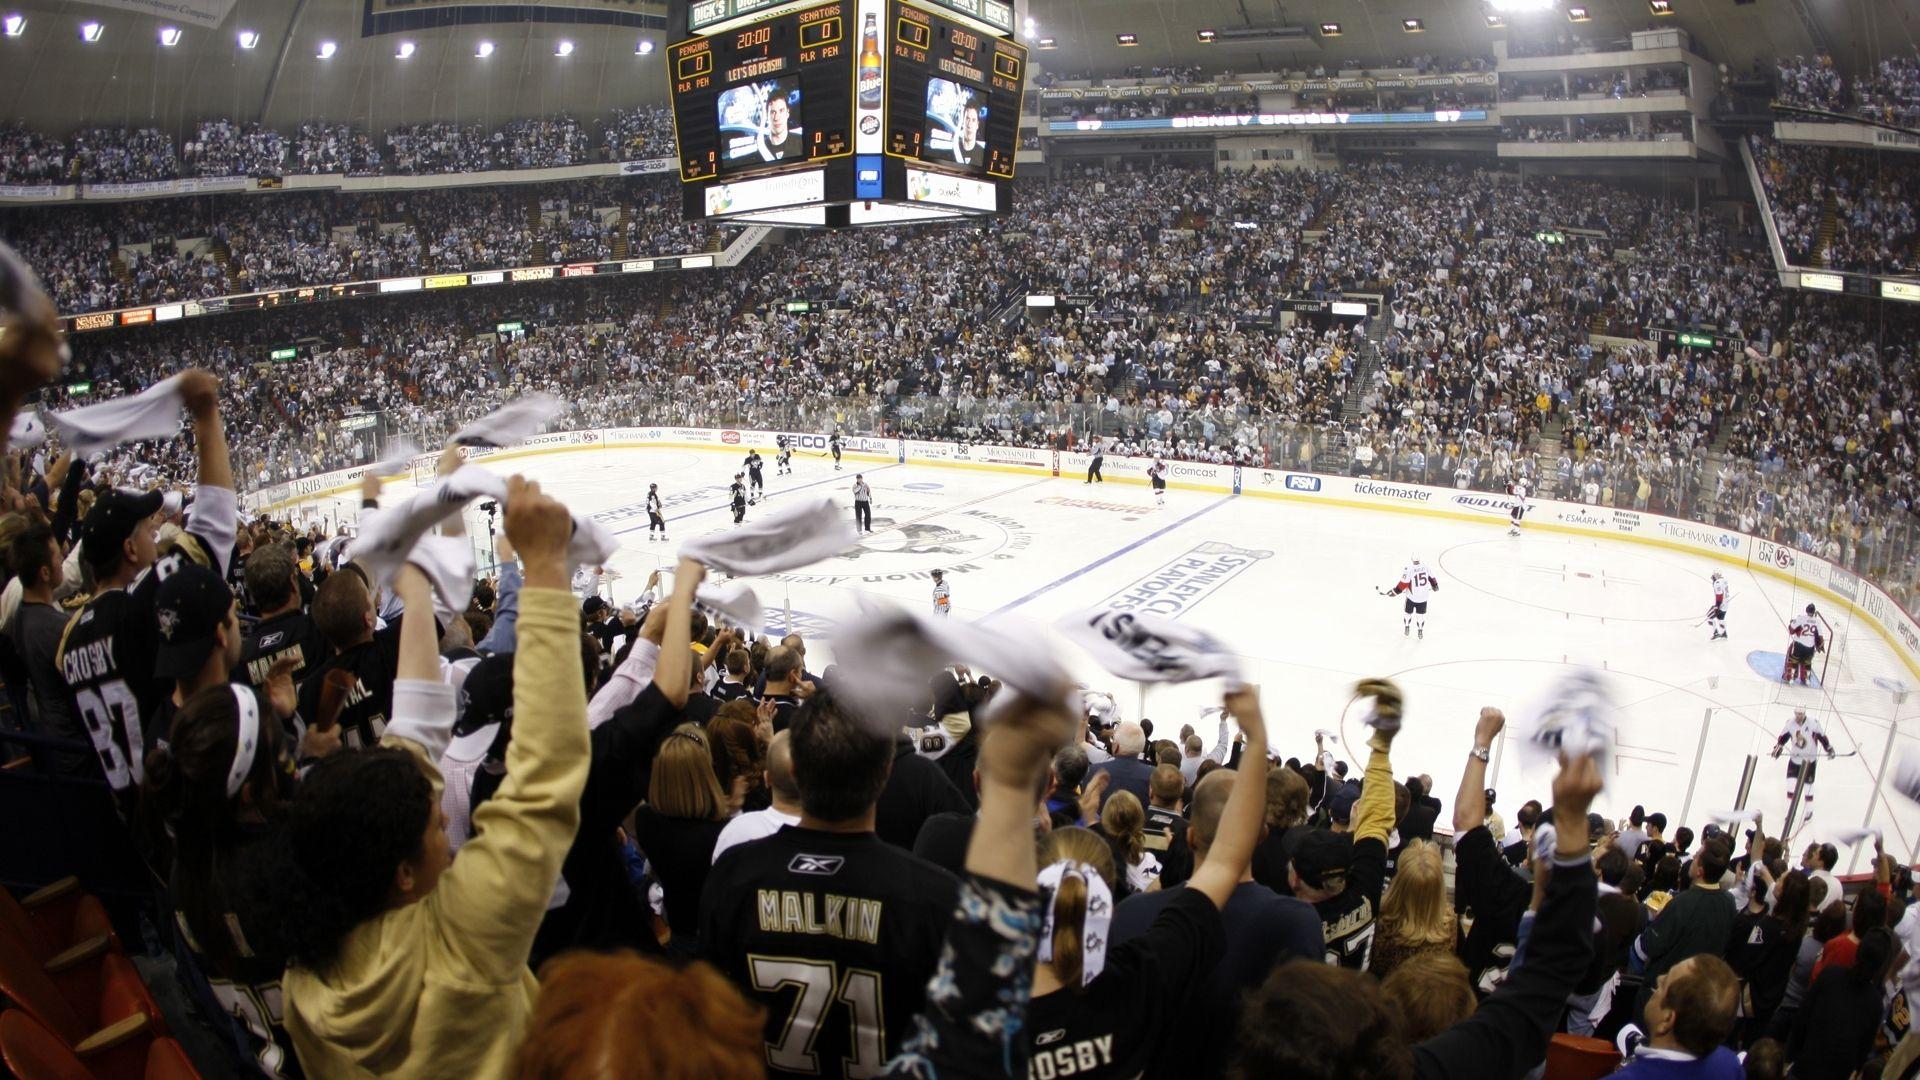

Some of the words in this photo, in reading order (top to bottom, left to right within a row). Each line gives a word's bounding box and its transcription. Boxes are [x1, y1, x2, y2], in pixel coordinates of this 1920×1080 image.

[694, 2, 726, 23] DICK'S
[799, 5, 841, 23] SENATORS
[901, 6, 930, 24] PENGUINS
[737, 27, 771, 49] 20:00
[822, 23, 831, 39] 0
[680, 40, 709, 56] PENGUINS
[951, 29, 977, 51] 20:00
[800, 51, 816, 63] PLR
[823, 45, 839, 58] PEN
[895, 44, 909, 57] PLR
[912, 50, 926, 63] PEN
[696, 56, 703, 71] 0
[940, 59, 957, 76] LET'S
[728, 66, 747, 82] LET'S
[748, 63, 757, 77] GO
[678, 82, 692, 93] PLR
[696, 77, 710, 89] PEN
[860, 77, 882, 93] Blue
[1172, 115, 1252, 128] SIDNEY
[1259, 112, 1349, 124] CROSBY
[726, 250, 741, 264] HAVE
[525, 436, 567, 446] DODGE
[779, 434, 826, 449] EICO
[860, 439, 887, 450] CLARK
[957, 445, 969, 455] 68
[986, 447, 1037, 460] MOUNTAINEER
[1068, 458, 1088, 466] UPMC
[1112, 462, 1141, 471] Medicine
[1173, 465, 1217, 478] comcast
[291, 479, 321, 496] TRIB
[1289, 476, 1317, 490] FSN
[1354, 480, 1432, 501] ticketmaster
[1456, 496, 1489, 507] BUD
[1491, 500, 1536, 512] LIGT
[1565, 514, 1598, 526] ESMARK
[1612, 516, 1641, 528] Pittsburgh
[1614, 510, 1640, 520] Wheeling
[1662, 522, 1718, 547] HIGHMARK
[1758, 541, 1775, 554] IT'S
[1758, 551, 1772, 563] ON
[1776, 549, 1789, 566] VS
[1108, 558, 1207, 611] PLAYOFFS
[1168, 555, 1247, 601] STANLEY
[1413, 572, 1427, 587] 15
[1830, 573, 1857, 597] Mellon
[1861, 582, 1884, 619] TRIB
[1801, 624, 1817, 637] 29
[1897, 618, 1919, 650] verizon
[64, 635, 117, 685] CROSBY
[76, 678, 144, 791] 87
[757, 889, 882, 945] MALKIN
[746, 953, 886, 1080] 71
[1028, 1033, 1115, 1080] ROSBY
